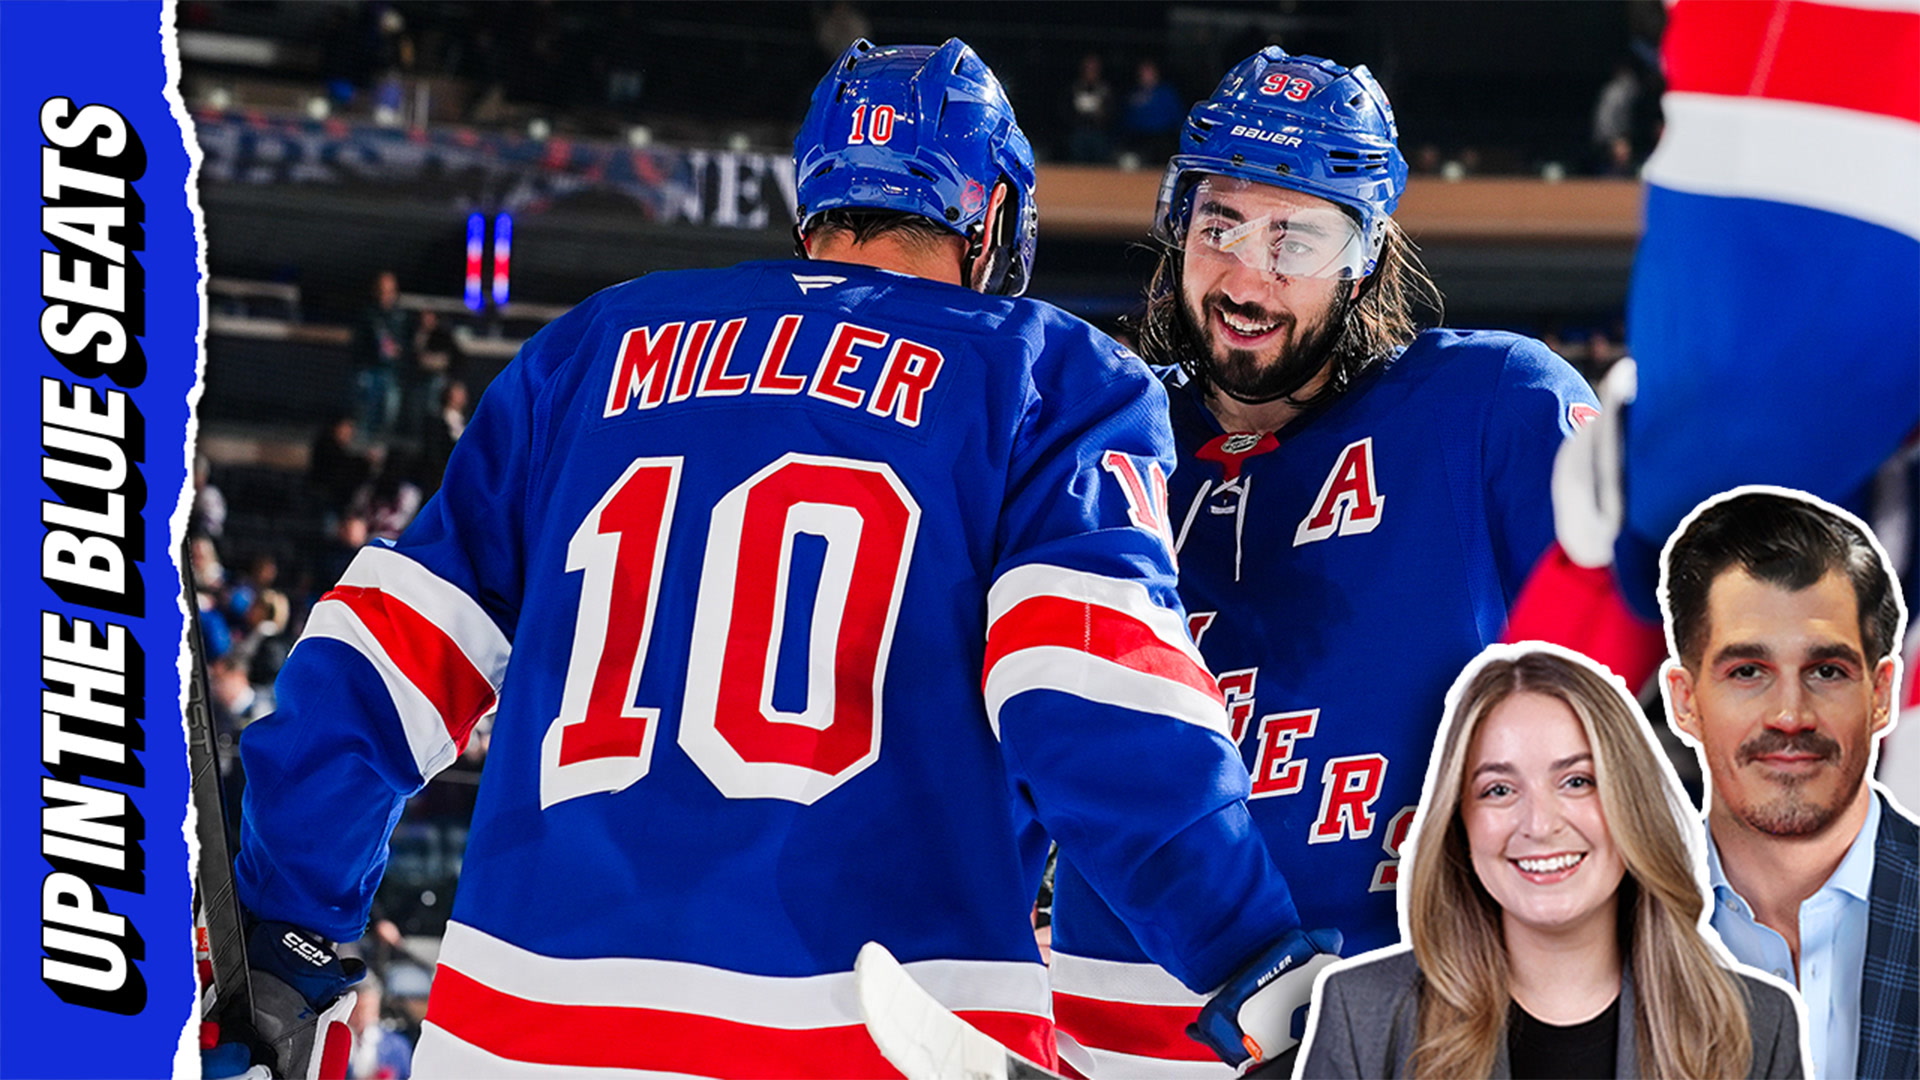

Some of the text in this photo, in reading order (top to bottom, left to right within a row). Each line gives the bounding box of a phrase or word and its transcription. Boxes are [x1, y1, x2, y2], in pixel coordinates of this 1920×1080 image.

[1260, 73, 1315, 102] 93
[847, 104, 895, 145] 10
[1230, 125, 1303, 148] BAUER
[603, 315, 945, 427] MILLER
[1292, 436, 1386, 548] A
[541, 452, 922, 810] 10
[283, 931, 333, 965] CCM
[1257, 954, 1293, 988] MILLER
